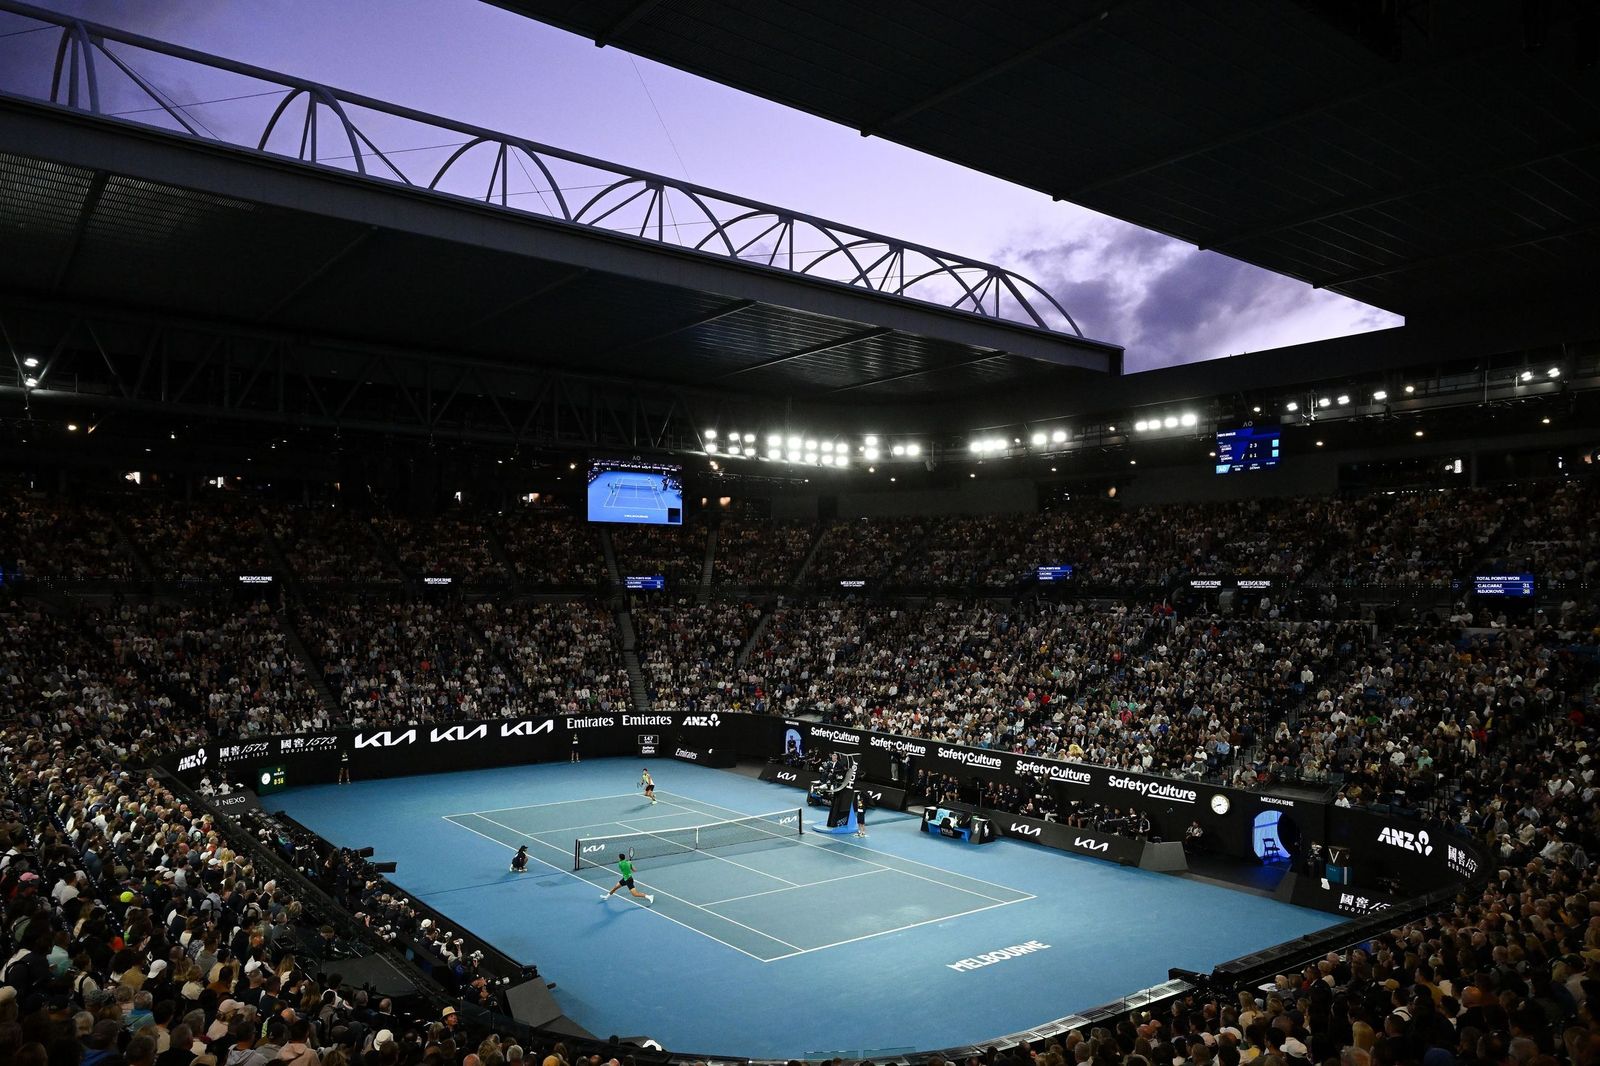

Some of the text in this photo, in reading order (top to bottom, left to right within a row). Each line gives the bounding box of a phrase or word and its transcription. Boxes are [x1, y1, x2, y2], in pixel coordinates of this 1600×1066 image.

[567, 716, 614, 728] Emirates
[622, 714, 672, 726] Emirates
[682, 716, 708, 726] ANZ
[430, 724, 487, 742] KIA
[501, 720, 554, 737] KIA
[811, 726, 860, 742] SafetyCulture
[355, 730, 416, 748] KIA
[675, 748, 697, 759] Emirates
[938, 748, 1001, 766] SafetyCulture
[178, 754, 196, 771] ANZ
[1108, 776, 1196, 800] SafetyCulture
[222, 796, 245, 806] NEXO
[1260, 796, 1294, 806] MELBOURNE
[1010, 822, 1041, 836] KIA
[1074, 836, 1109, 851] KIA
[1377, 827, 1415, 851] ANZ
[945, 940, 1052, 972] MELBOURNE
